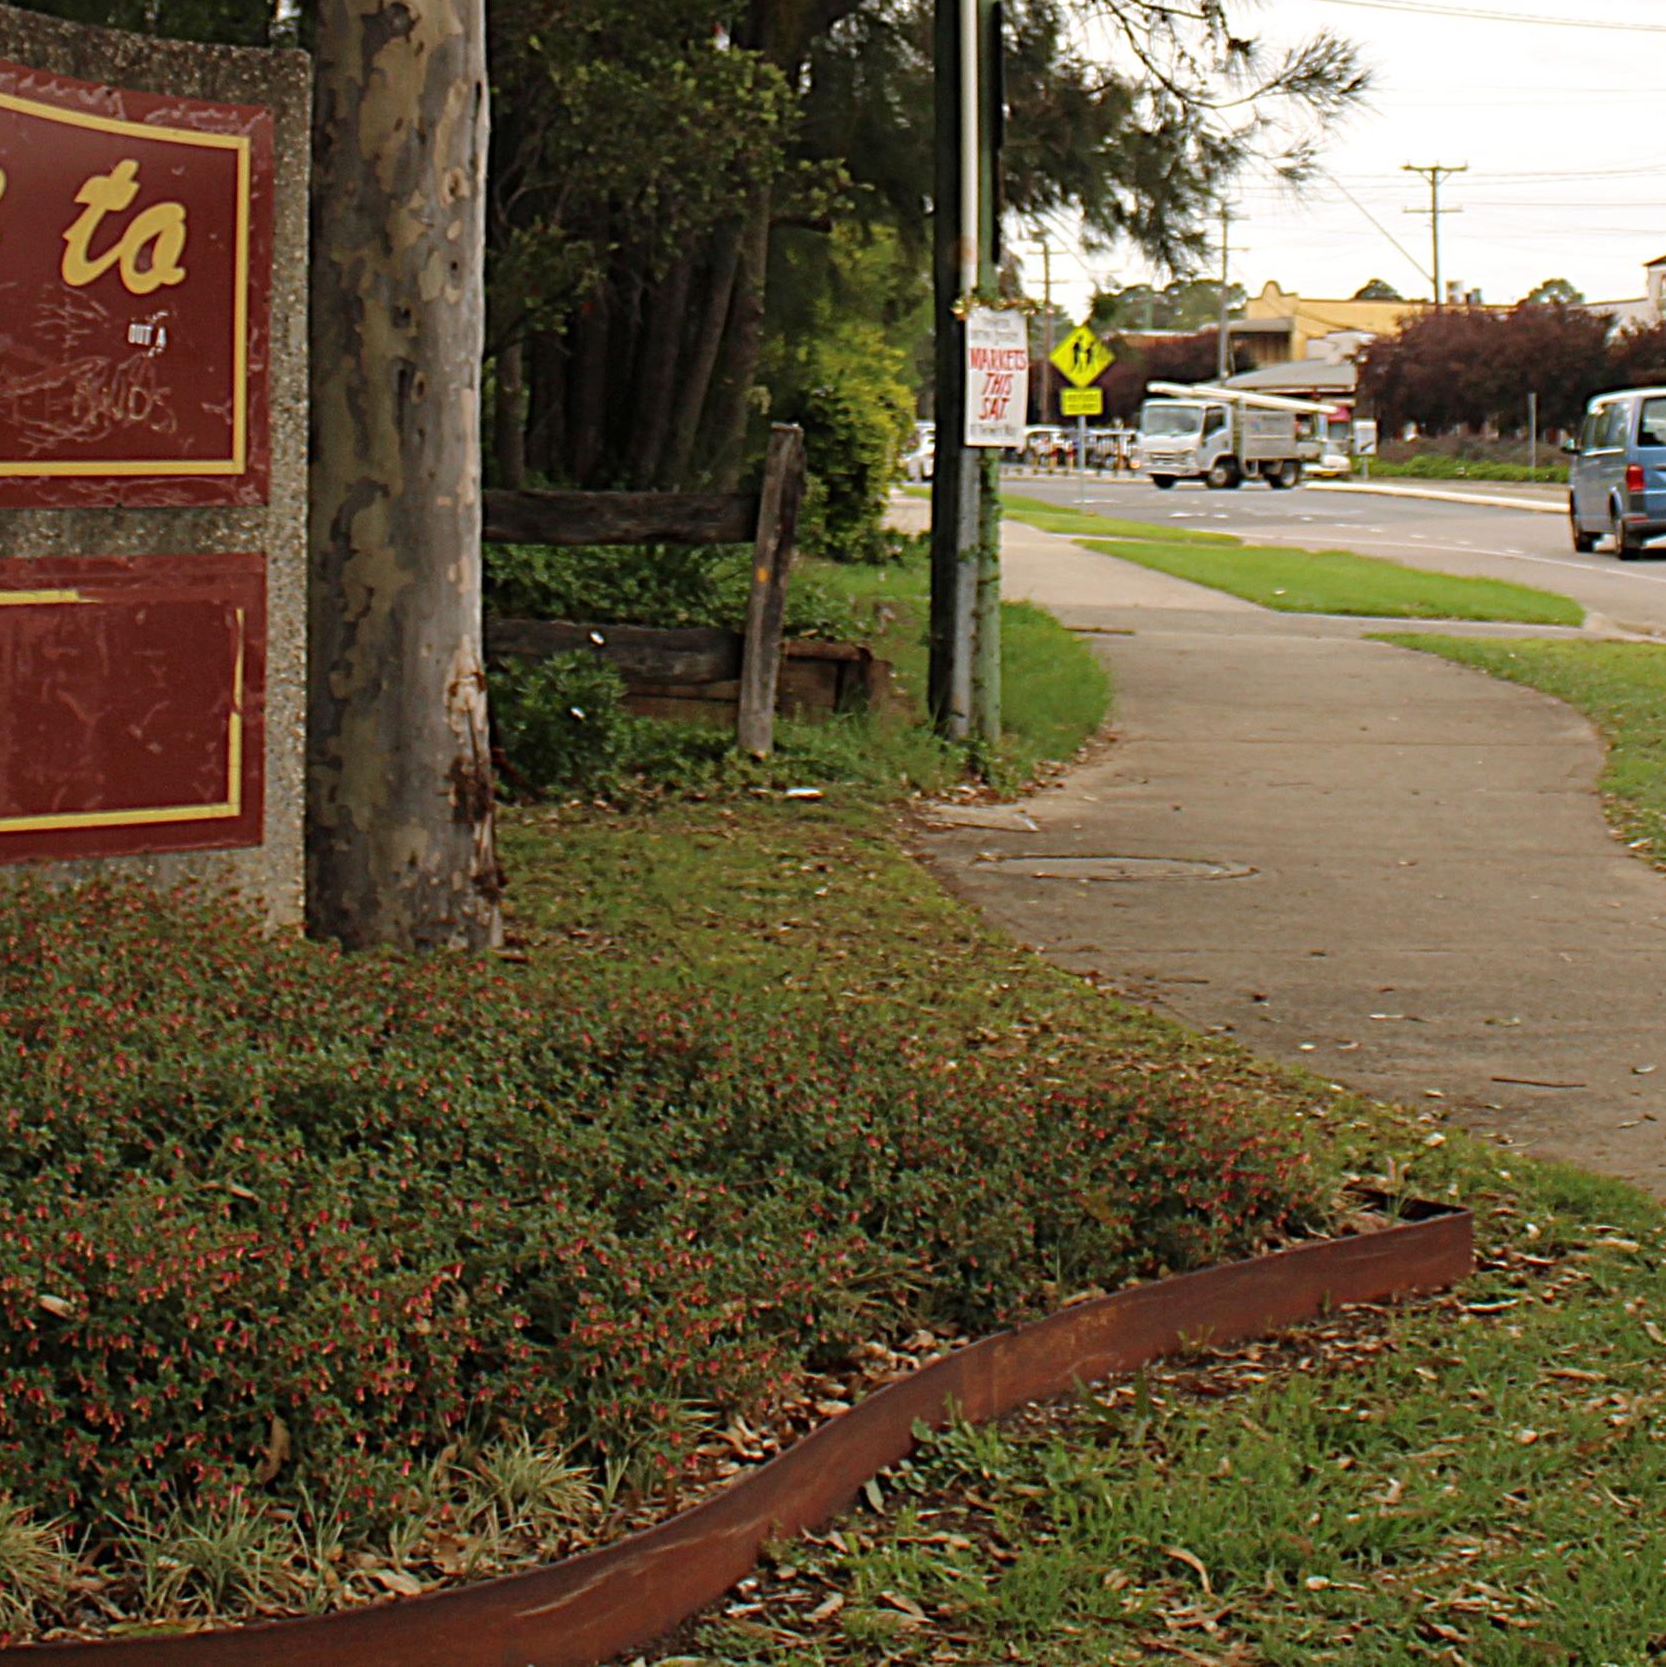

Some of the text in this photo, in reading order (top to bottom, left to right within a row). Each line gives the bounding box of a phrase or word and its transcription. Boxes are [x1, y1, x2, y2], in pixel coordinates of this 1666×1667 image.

[61, 159, 187, 295] to
[969, 347, 1028, 371] MARKETS
[982, 372, 1014, 395] THIS
